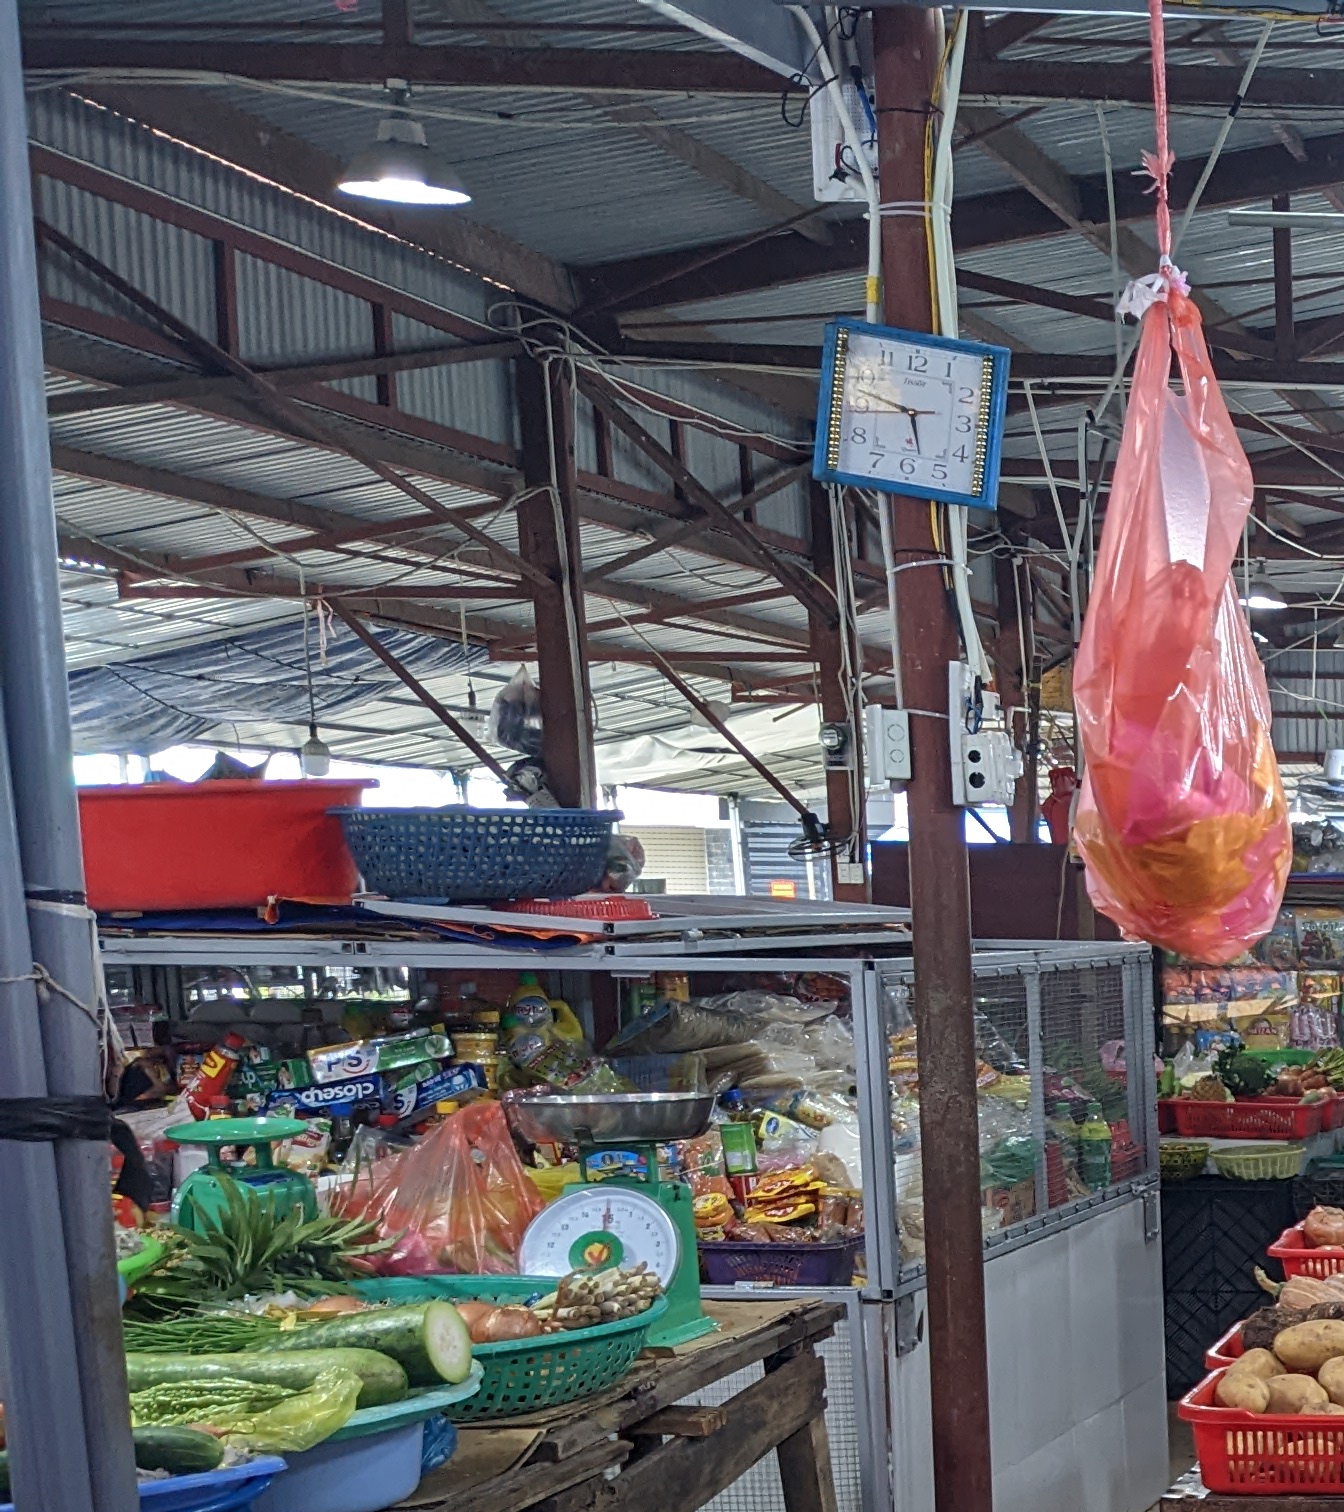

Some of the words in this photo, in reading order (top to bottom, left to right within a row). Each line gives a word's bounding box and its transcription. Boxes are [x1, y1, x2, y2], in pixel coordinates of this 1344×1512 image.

[879, 350, 894, 367] 11
[907, 355, 928, 373] 12
[945, 362, 952, 378] 1
[958, 387, 975, 404] 2
[854, 397, 869, 415] 9
[955, 415, 972, 433] 3
[851, 427, 867, 445] 8
[869, 452, 885, 469] 7
[952, 444, 969, 463] 4
[899, 458, 916, 475] 6
[931, 463, 948, 481] 5
[302, 1082, 375, 1102] closeup
